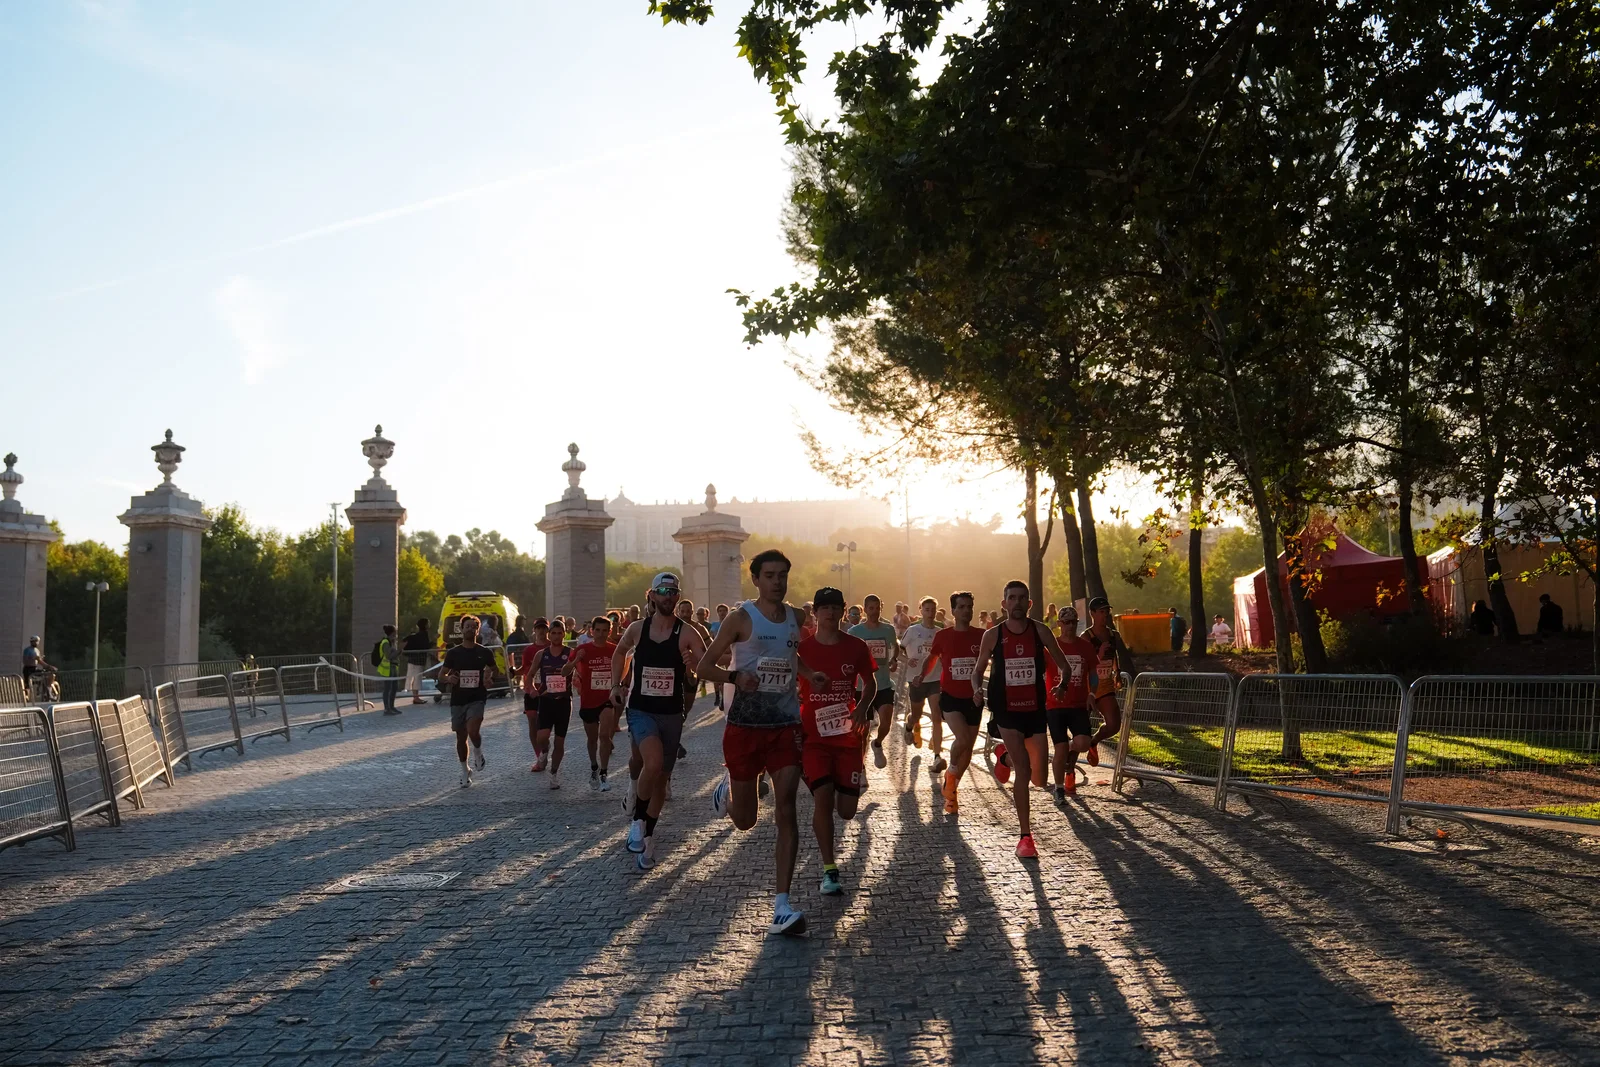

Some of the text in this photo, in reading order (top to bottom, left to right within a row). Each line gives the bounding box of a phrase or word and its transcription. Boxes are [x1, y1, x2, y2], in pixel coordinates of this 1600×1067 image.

[761, 673, 787, 684] 1711
[1009, 670, 1032, 679] 1419
[646, 680, 670, 689] 1423
[810, 691, 852, 701] CORAZÓN
[822, 718, 847, 731] 1127
